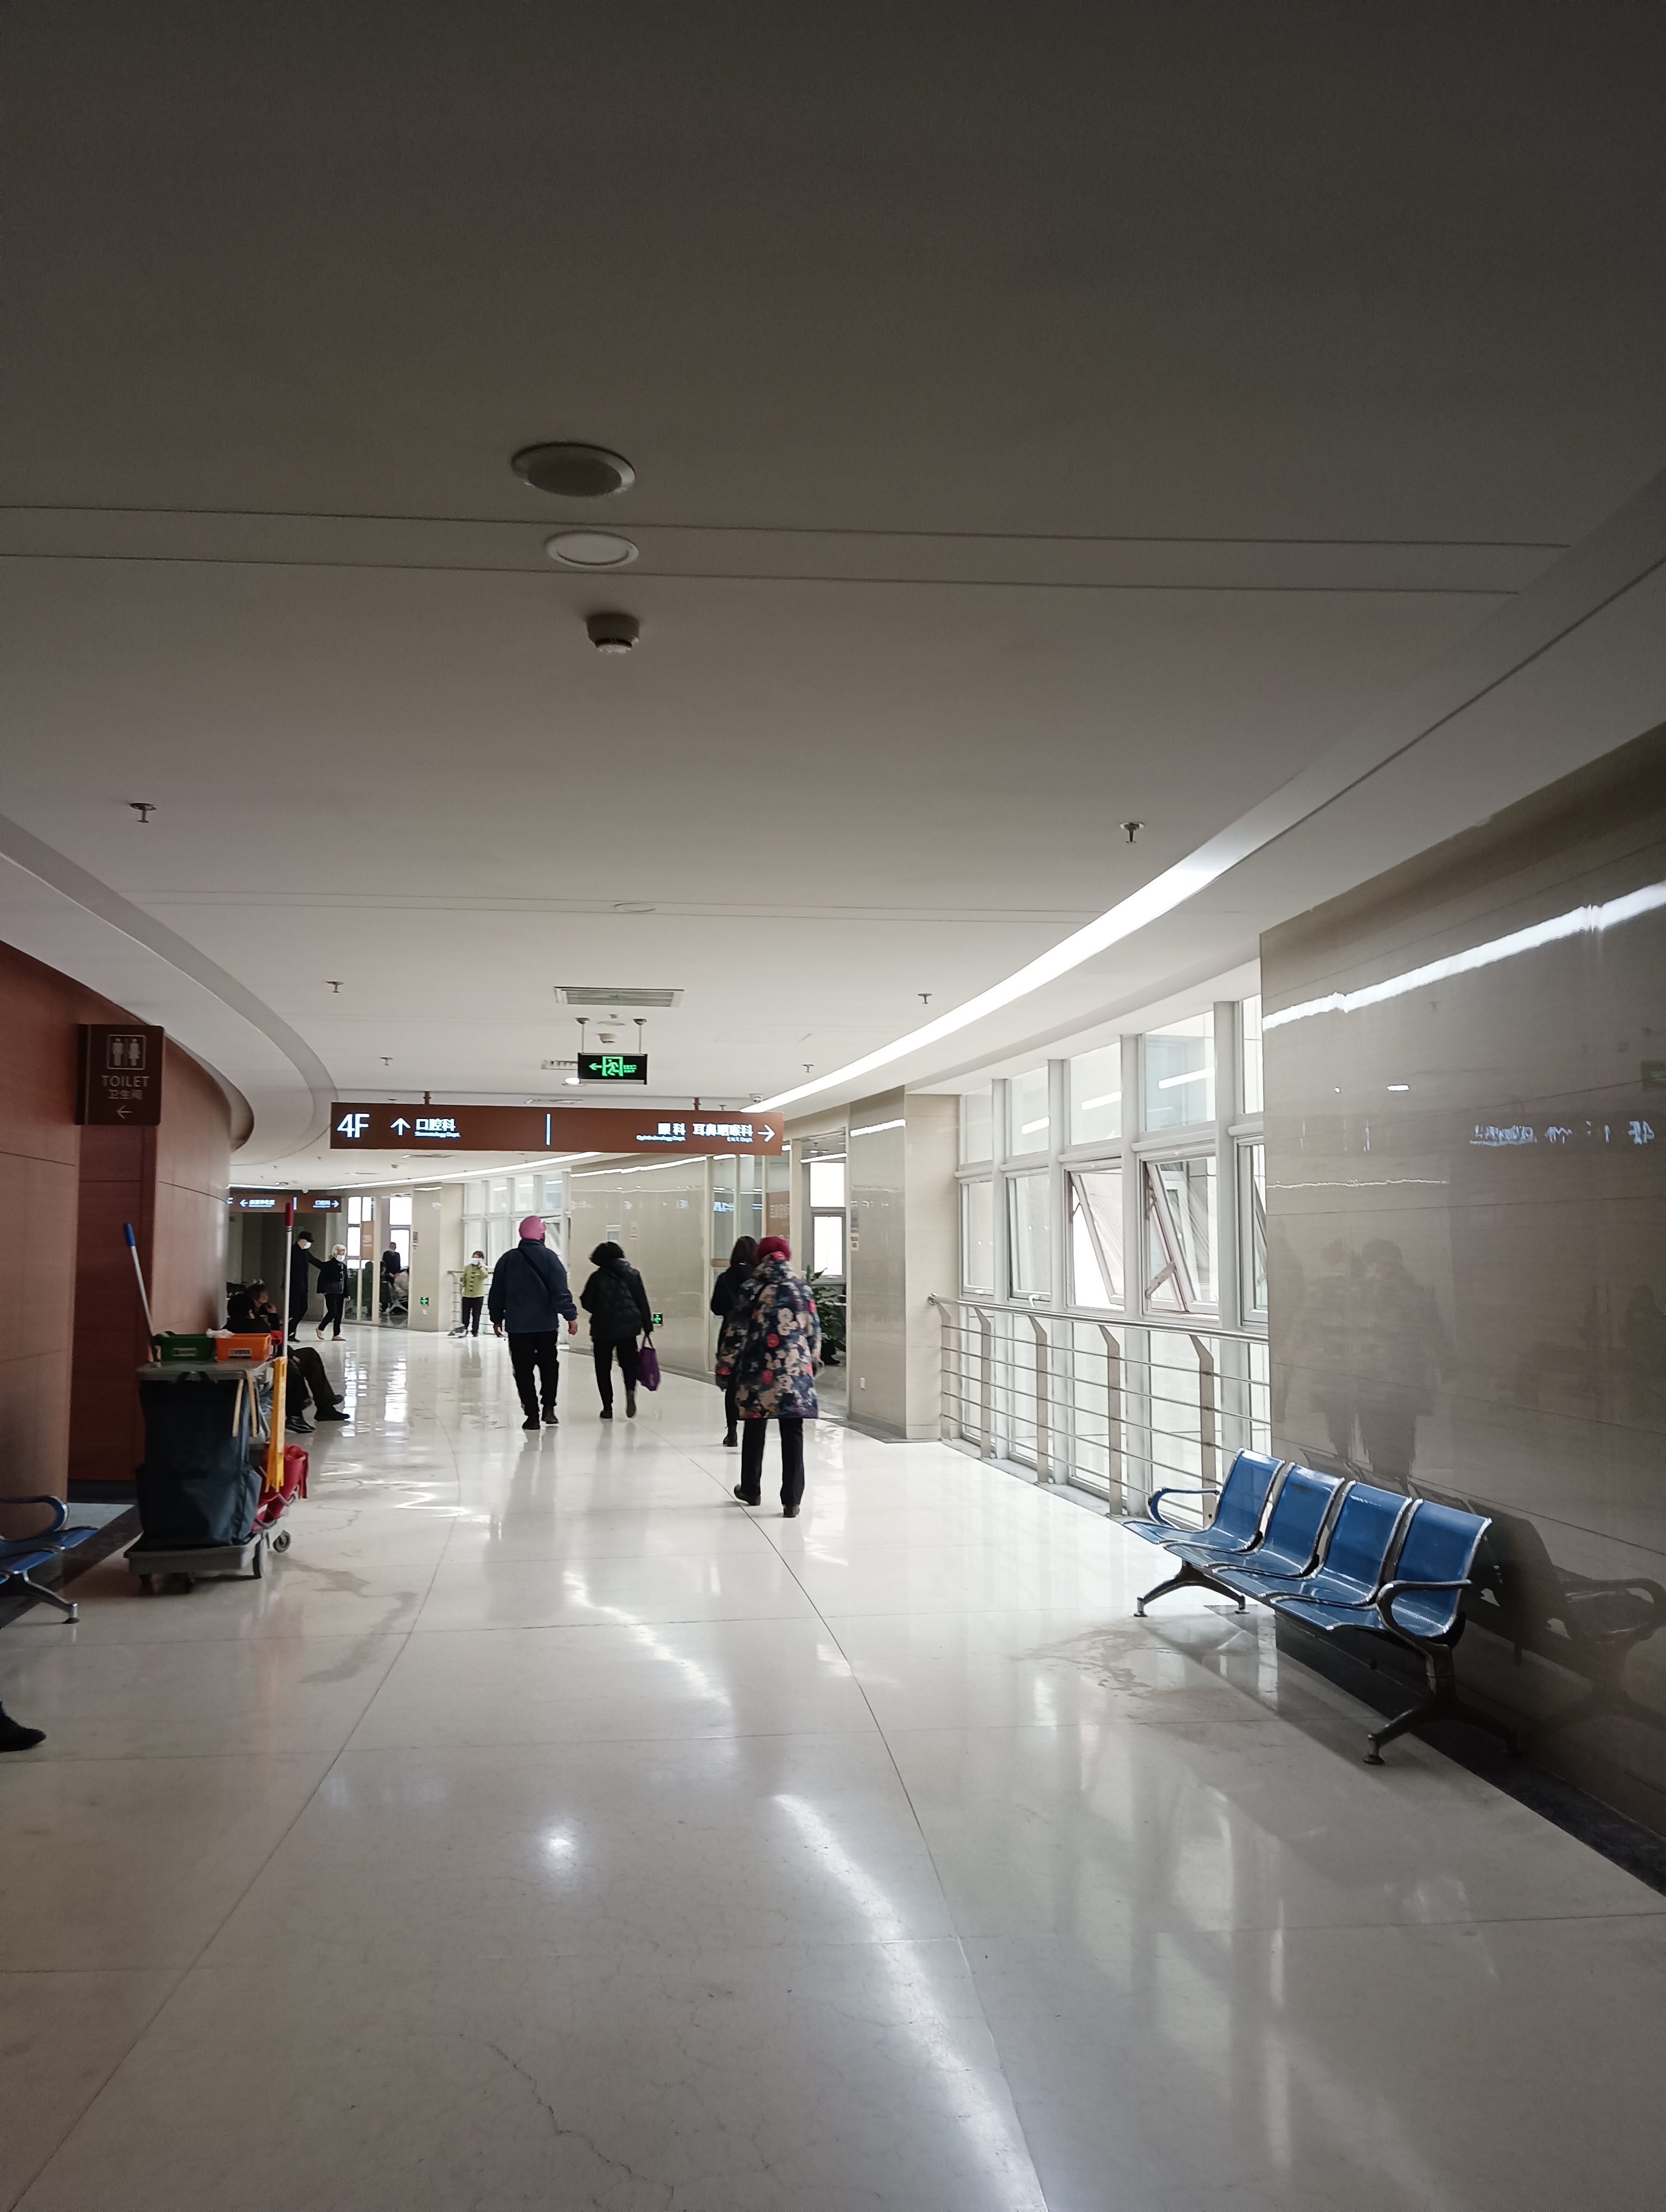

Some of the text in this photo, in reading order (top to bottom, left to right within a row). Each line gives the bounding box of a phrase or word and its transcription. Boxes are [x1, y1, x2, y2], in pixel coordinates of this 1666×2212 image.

[101, 1075, 150, 1087] TOILET
[107, 1089, 143, 1100] 卫生间
[336, 1113, 370, 1138] 4F
[415, 1118, 456, 1131] 口腔科
